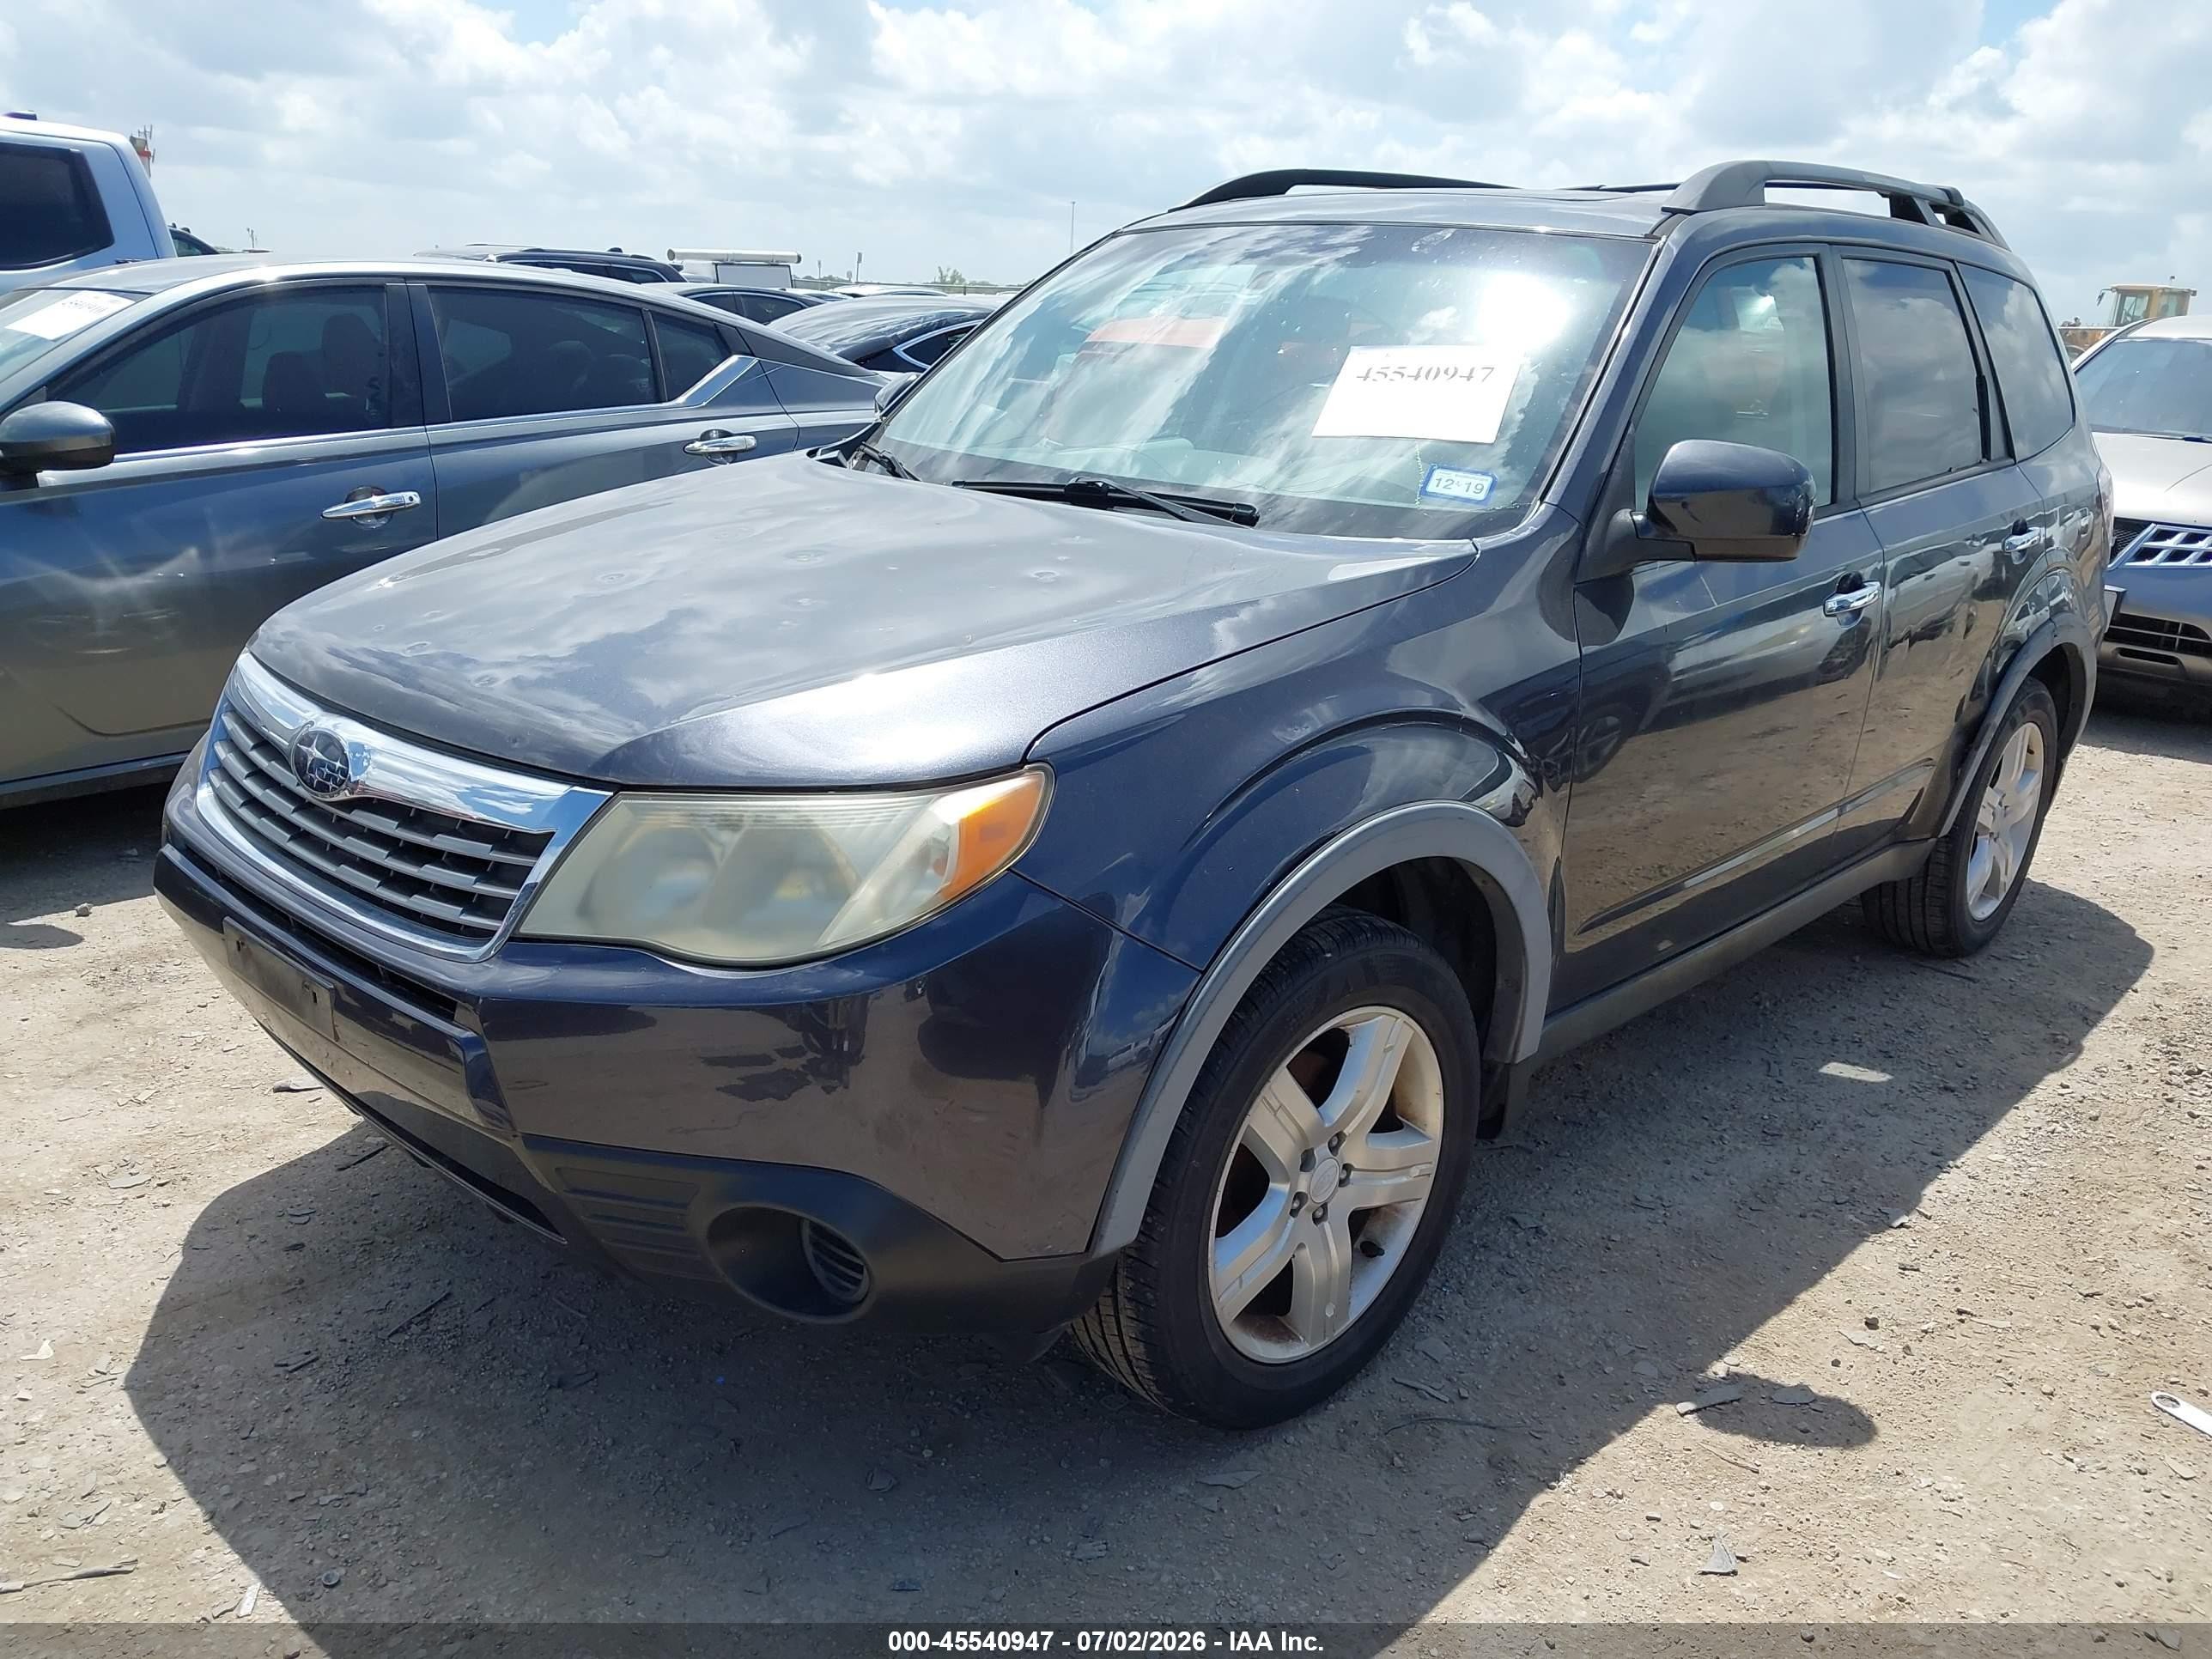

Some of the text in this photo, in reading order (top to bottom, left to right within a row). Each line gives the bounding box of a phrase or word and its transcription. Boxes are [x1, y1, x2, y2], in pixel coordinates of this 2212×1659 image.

[1356, 366, 1495, 382] 45540947
[1435, 477, 1485, 495] 12 19
